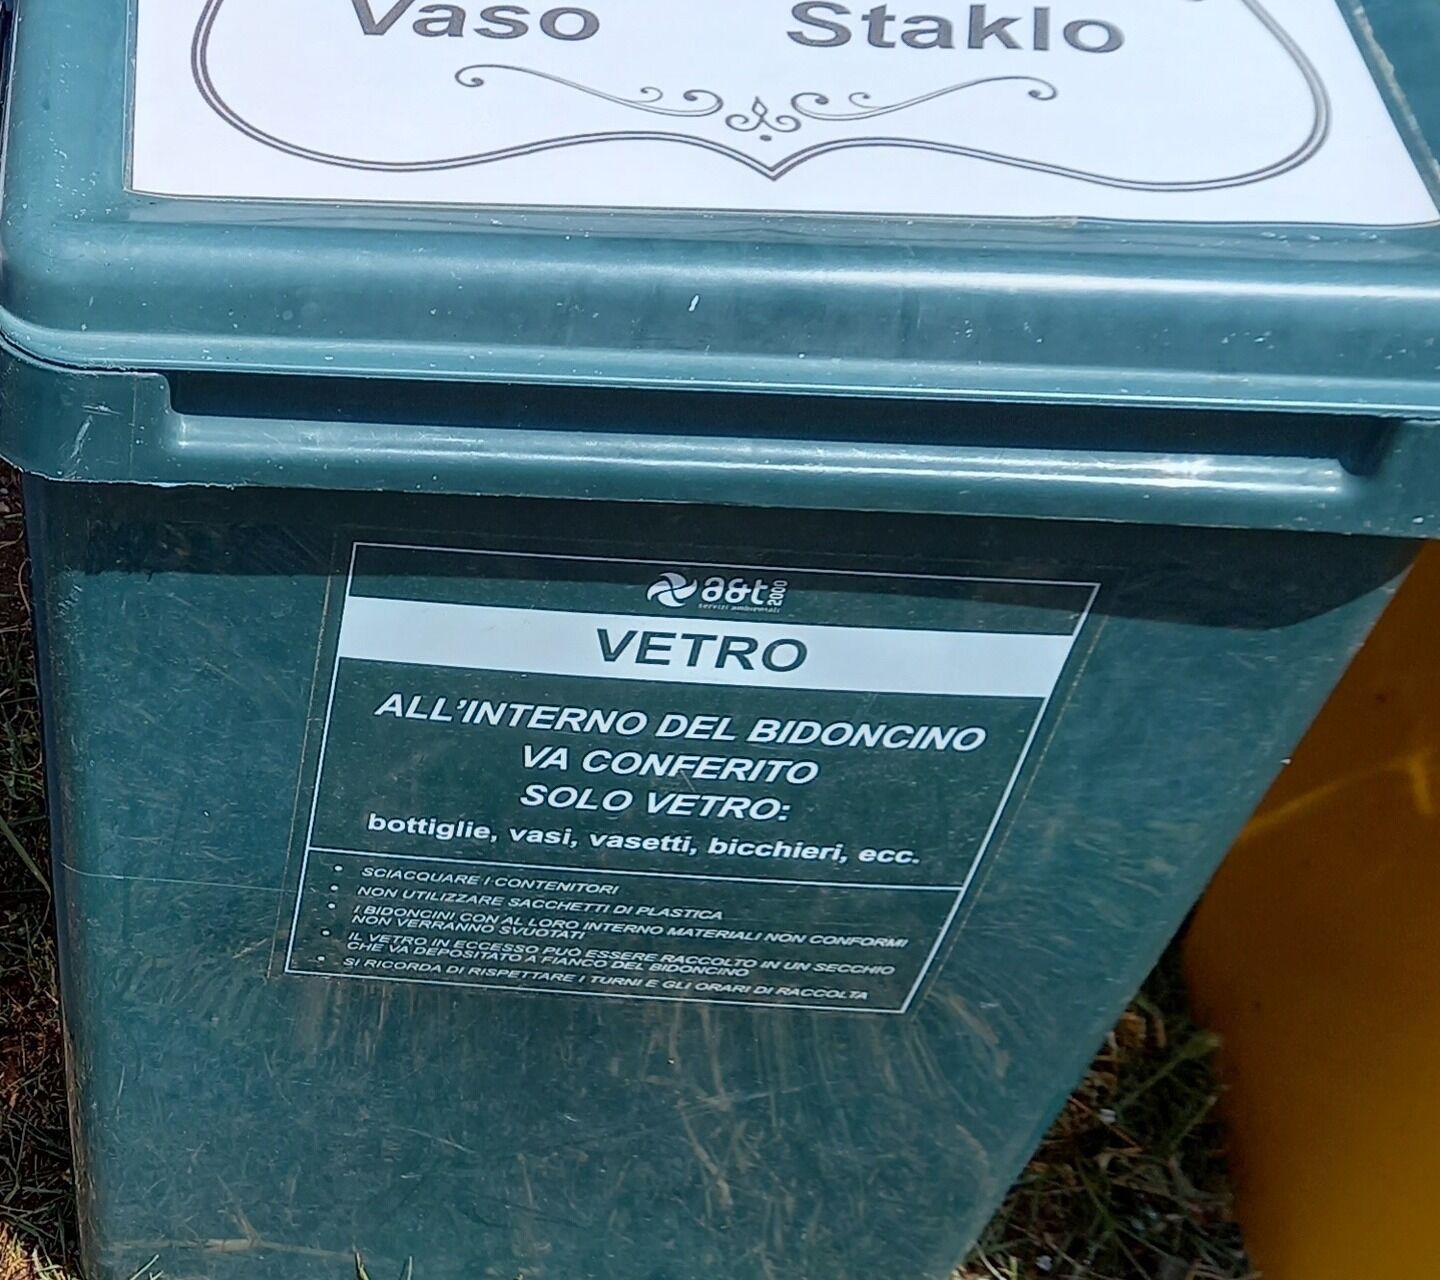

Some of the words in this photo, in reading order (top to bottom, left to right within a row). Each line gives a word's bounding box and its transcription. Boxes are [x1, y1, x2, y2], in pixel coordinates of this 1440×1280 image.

[786, 0, 1125, 53] Staklo
[701, 577, 768, 605] a&t
[767, 580, 788, 606] 2000
[596, 629, 808, 673] VETRO
[654, 713, 736, 742] DEL
[747, 718, 986, 752] BIDONCINO
[521, 745, 568, 771] VA
[582, 748, 820, 785] CONFERITO
[521, 784, 631, 812] SOLO
[646, 792, 790, 821] VETRO:
[367, 813, 498, 848] bottiglie,
[508, 825, 578, 850] vasi,
[589, 829, 699, 856] vasetti,
[707, 835, 847, 865] bicchieri,
[858, 845, 920, 866] ecc.
[361, 867, 480, 885] SCIACQUARE
[494, 877, 619, 895] CONTENITORI
[357, 886, 398, 898] NON
[402, 890, 505, 906] UTILIZZARE
[508, 897, 609, 913] SACCHETTI
[613, 904, 632, 914] DI
[636, 906, 723, 920] PLASTICA
[352, 915, 391, 925] NON
[397, 919, 494, 934] VERRANNO
[498, 926, 585, 940] SVUOTATI
[364, 905, 455, 920] BIDONCINI
[459, 912, 500, 924] CON
[503, 916, 523, 925] AL
[528, 917, 579, 930] LORO
[582, 922, 664, 936] INTERNO
[667, 927, 762, 941] MATERIALI
[764, 932, 807, 943] NON
[810, 934, 909, 948] CONFORMI
[346, 942, 383, 951] CHE
[388, 944, 409, 953] VA
[413, 947, 522, 962] DEPOSITATO
[524, 954, 537, 963] A
[541, 955, 608, 968] FIANCO
[610, 961, 644, 971] DEL
[649, 963, 749, 977] BIDONCINO
[348, 932, 363, 941] IL
[369, 934, 427, 946] VETRO
[431, 938, 450, 948] IN
[453, 940, 539, 953] ECCESSO
[585, 949, 657, 962] ESSERE
[660, 954, 758, 968] RACCOLTO
[760, 960, 780, 970] IN
[784, 961, 811, 970] UN
[814, 963, 895, 975] SECCHIO
[343, 958, 360, 966] SI
[364, 959, 442, 973] RICORDA
[446, 965, 463, 974] DI
[468, 967, 574, 983] RISPETTARE
[590, 975, 643, 987] TURNI
[645, 979, 658, 988] E
[662, 980, 692, 990] GLI
[695, 982, 751, 993] ORARI
[754, 985, 773, 995] DI
[775, 987, 868, 1000] RACCOLTA
